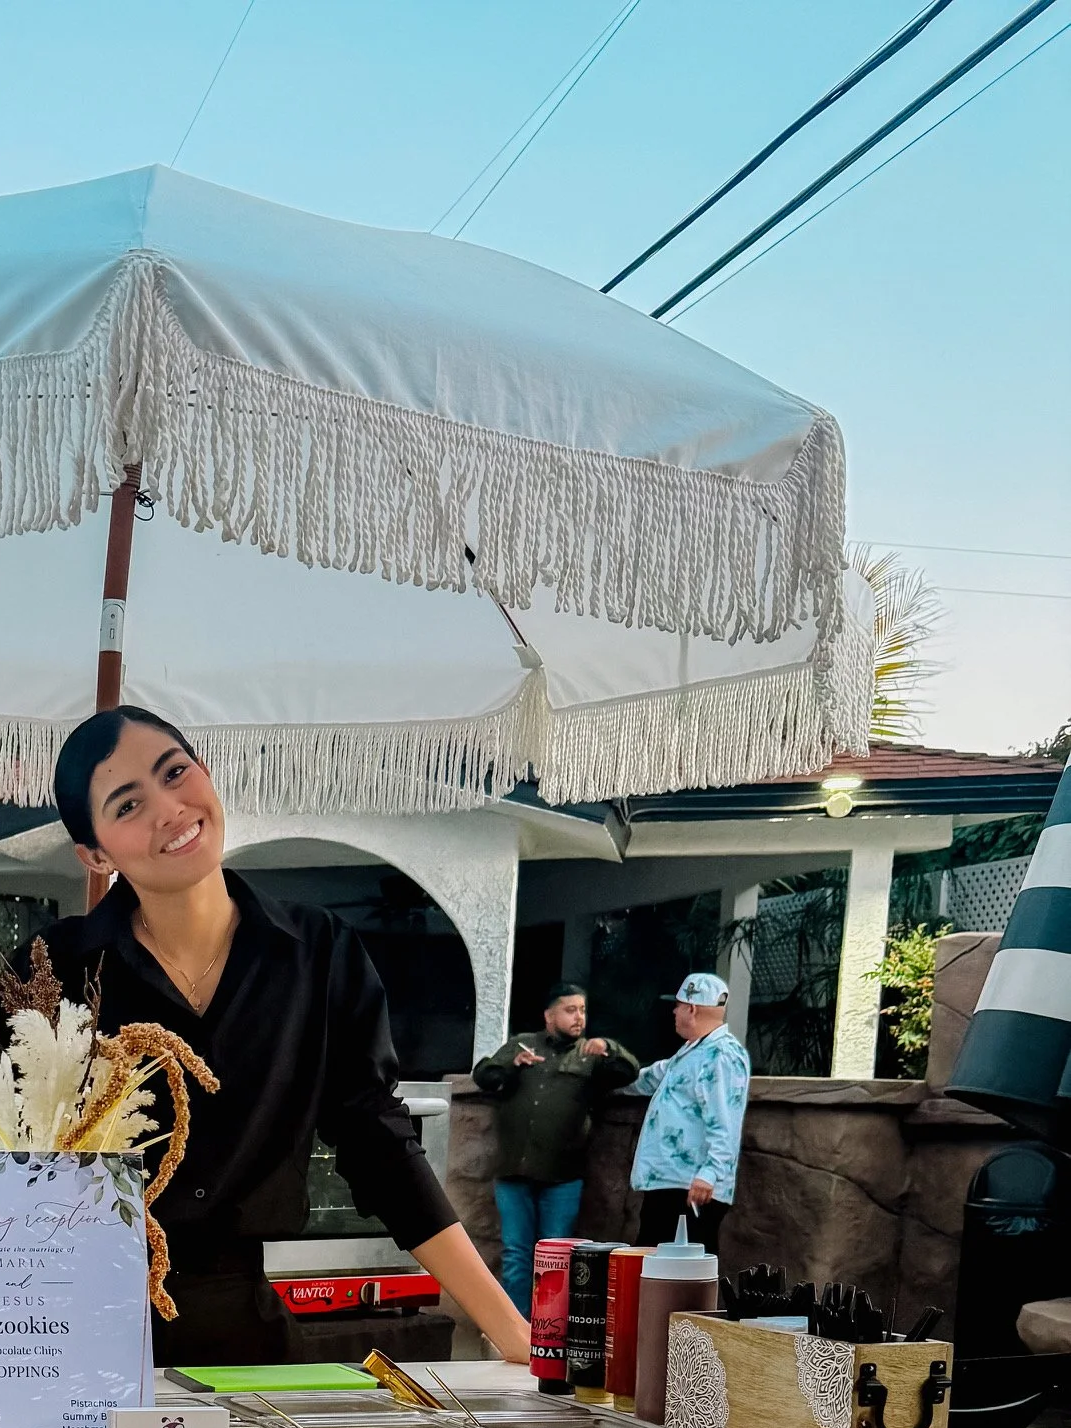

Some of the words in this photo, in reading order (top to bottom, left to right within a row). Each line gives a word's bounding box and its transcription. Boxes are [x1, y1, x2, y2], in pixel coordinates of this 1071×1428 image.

[25, 1201, 122, 1244] reception
[29, 1246, 64, 1254] marriage
[5, 1273, 33, 1290] and
[34, 1346, 63, 1357] Chips
[529, 1347, 564, 1358] LYON
[70, 1399, 118, 1408] Pistachios
[62, 1412, 98, 1423] Gummy
